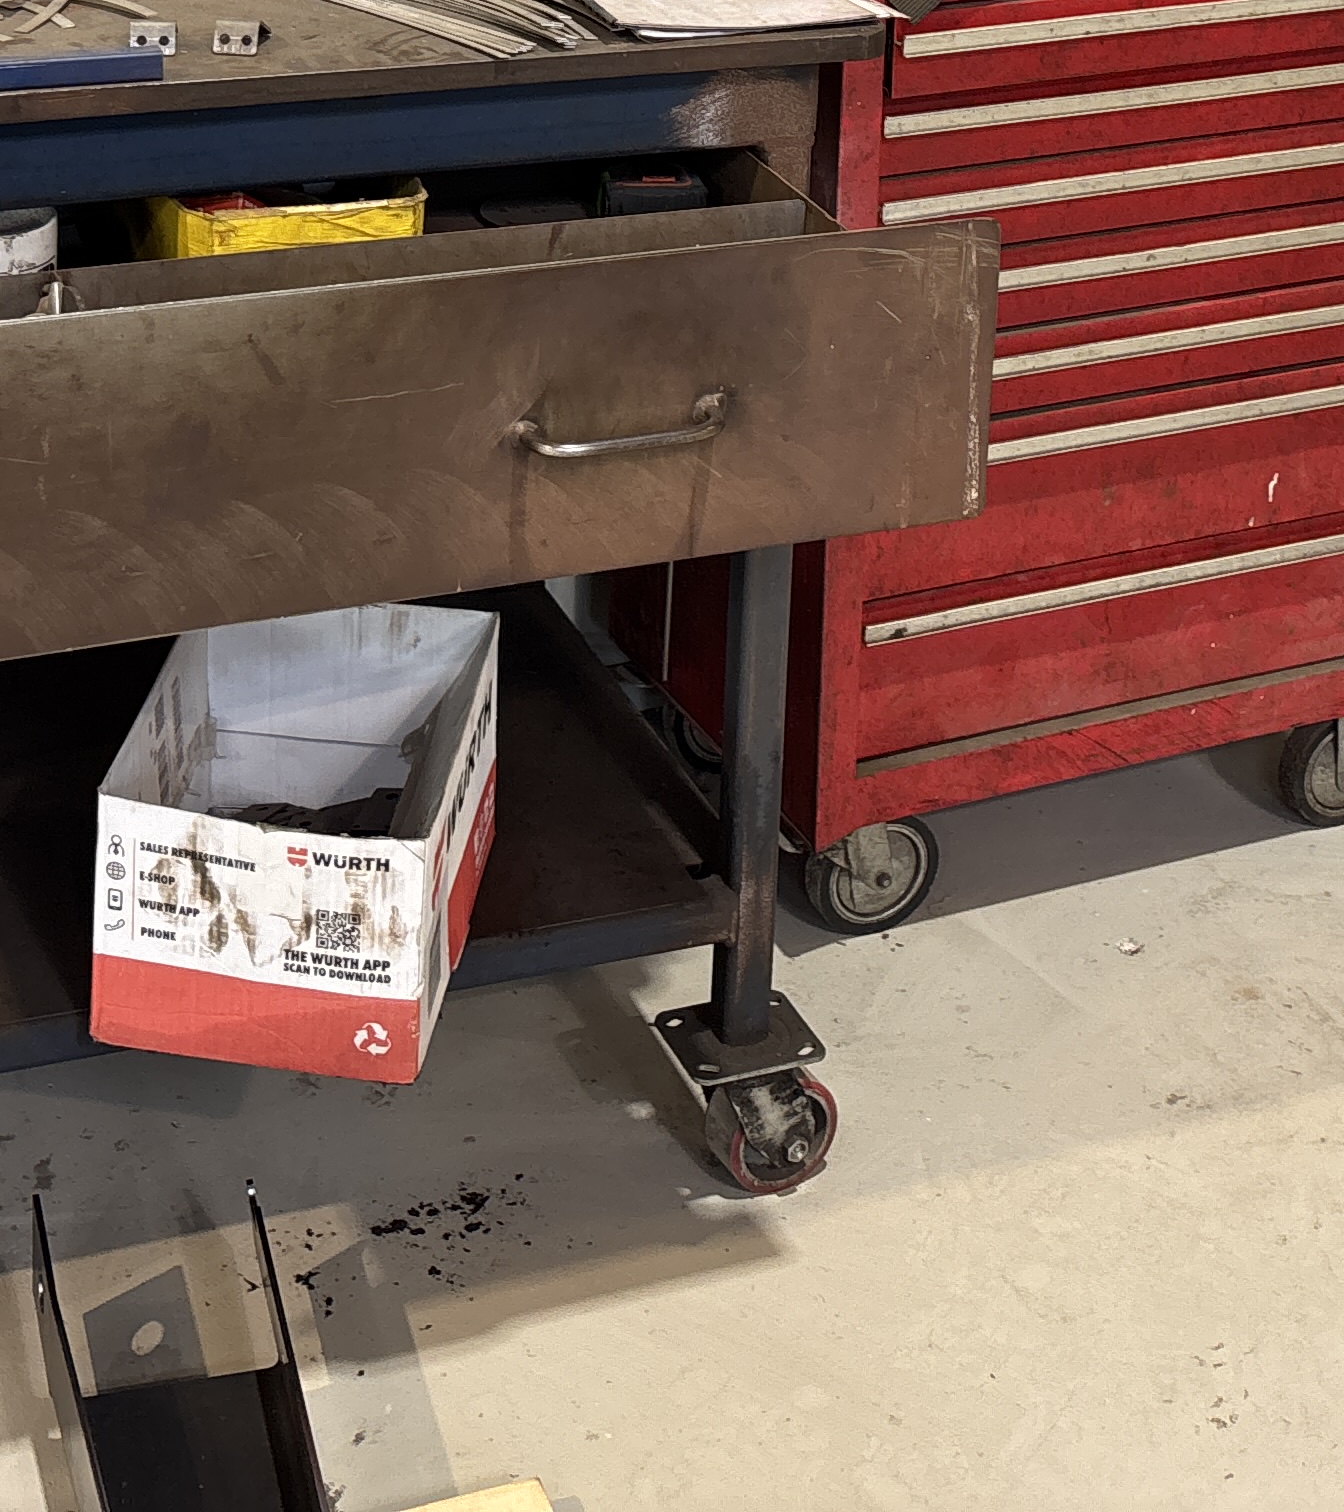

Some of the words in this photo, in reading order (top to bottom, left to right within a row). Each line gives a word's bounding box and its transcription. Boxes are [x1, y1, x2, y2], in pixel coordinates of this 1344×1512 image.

[140, 841, 169, 856] SALES
[171, 847, 256, 872] REPRESENTATIVE
[139, 871, 176, 886] E-SHOP
[179, 905, 200, 918] APP
[140, 926, 177, 941] PHONE
[283, 948, 308, 963] THE
[362, 959, 391, 972] APP
[283, 962, 310, 975] SCAN
[313, 966, 326, 977] TO
[328, 969, 391, 984] DOWNLOAD
